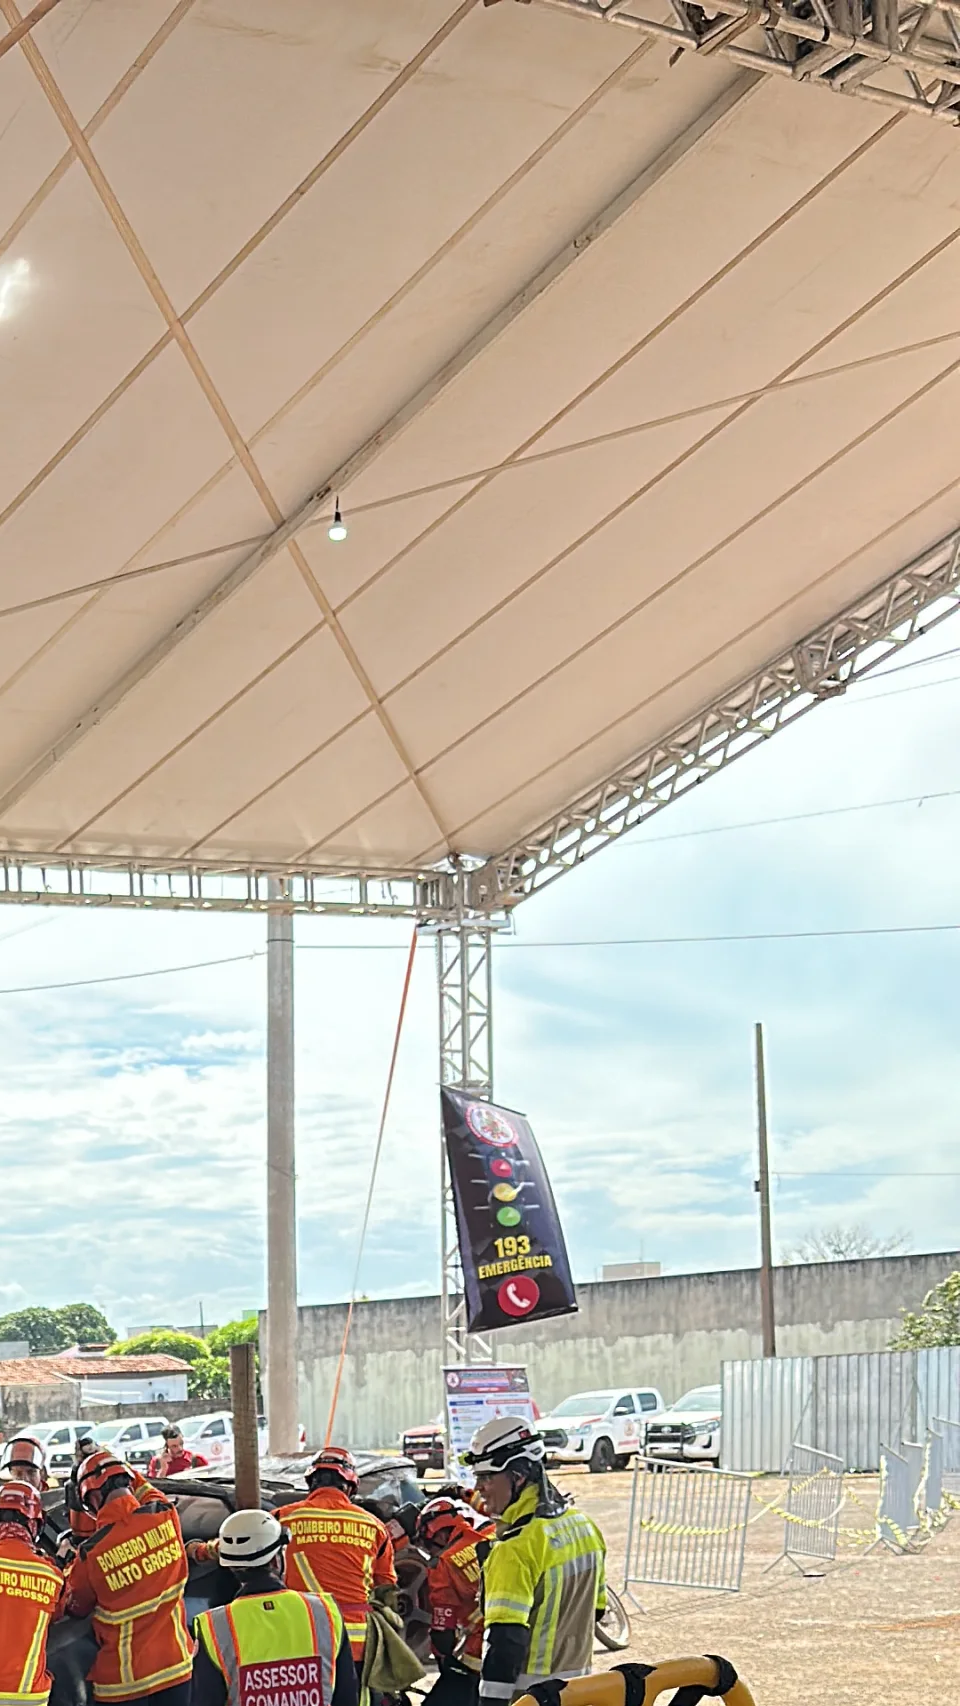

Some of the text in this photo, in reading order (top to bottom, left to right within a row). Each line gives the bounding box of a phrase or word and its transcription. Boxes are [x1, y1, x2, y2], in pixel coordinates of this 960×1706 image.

[494, 1235, 531, 1258] 193
[478, 1255, 552, 1279] EMERGÊNCIA
[290, 1520, 377, 1542] BOMBEIRO MILITAR
[296, 1534, 372, 1550] MATO GROSSO
[96, 1536, 147, 1573] BOMBEIRO
[20, 1574, 57, 1597] MILITAR
[105, 1563, 142, 1592] MATO
[6, 1586, 50, 1605] GROSSO
[244, 1663, 319, 1692] ASSESSOR
